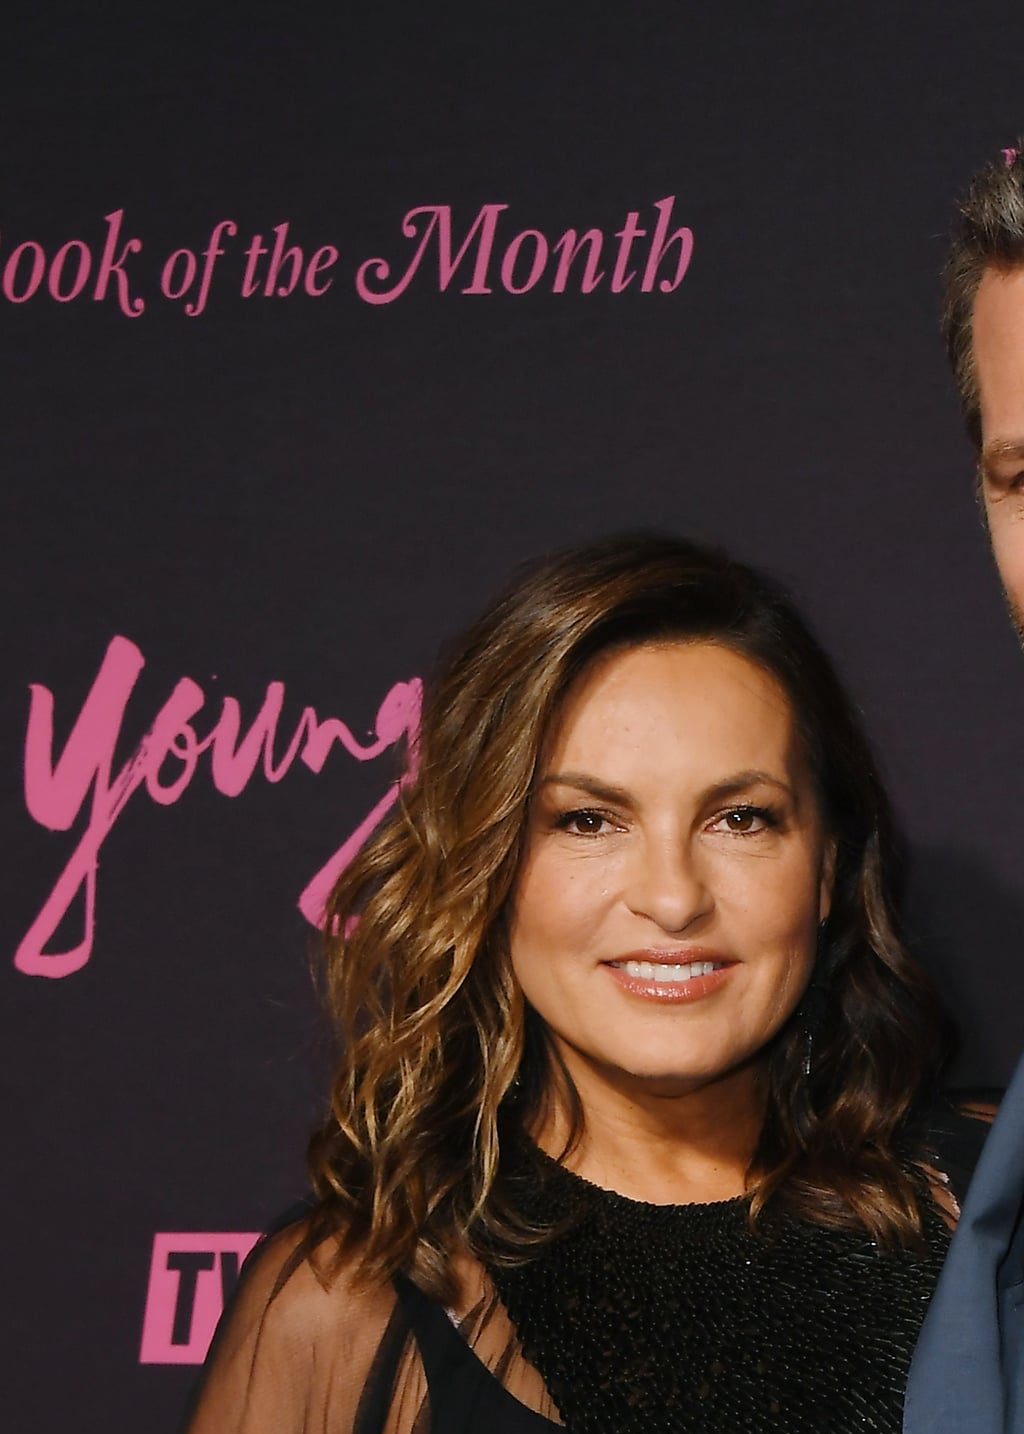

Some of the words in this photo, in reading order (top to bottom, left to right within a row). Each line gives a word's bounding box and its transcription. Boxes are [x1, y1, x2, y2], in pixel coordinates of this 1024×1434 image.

[160, 220, 238, 317] of
[241, 222, 339, 298] the
[355, 195, 695, 305] Month
